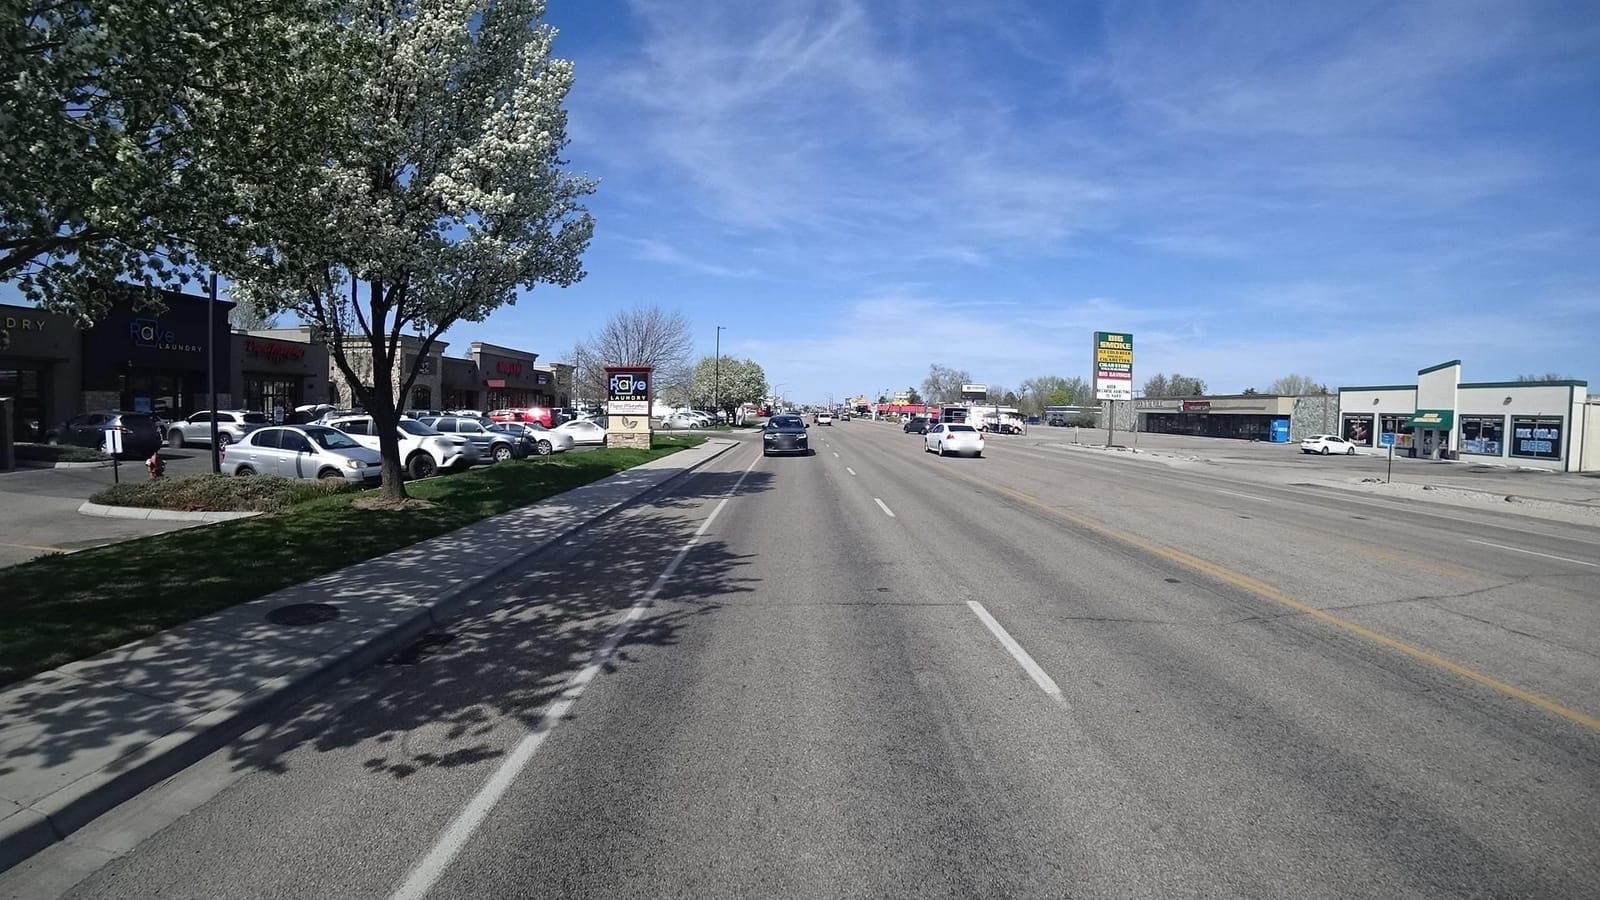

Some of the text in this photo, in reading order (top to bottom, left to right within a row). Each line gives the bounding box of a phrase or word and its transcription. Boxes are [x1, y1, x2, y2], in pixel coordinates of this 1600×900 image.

[6, 317, 46, 331] DRY
[130, 321, 175, 343] Rave
[159, 343, 203, 353] LAUNDRY
[1099, 341, 1131, 350] SMOKE
[610, 378, 647, 391] Rave
[1520, 440, 1552, 452] BEER
